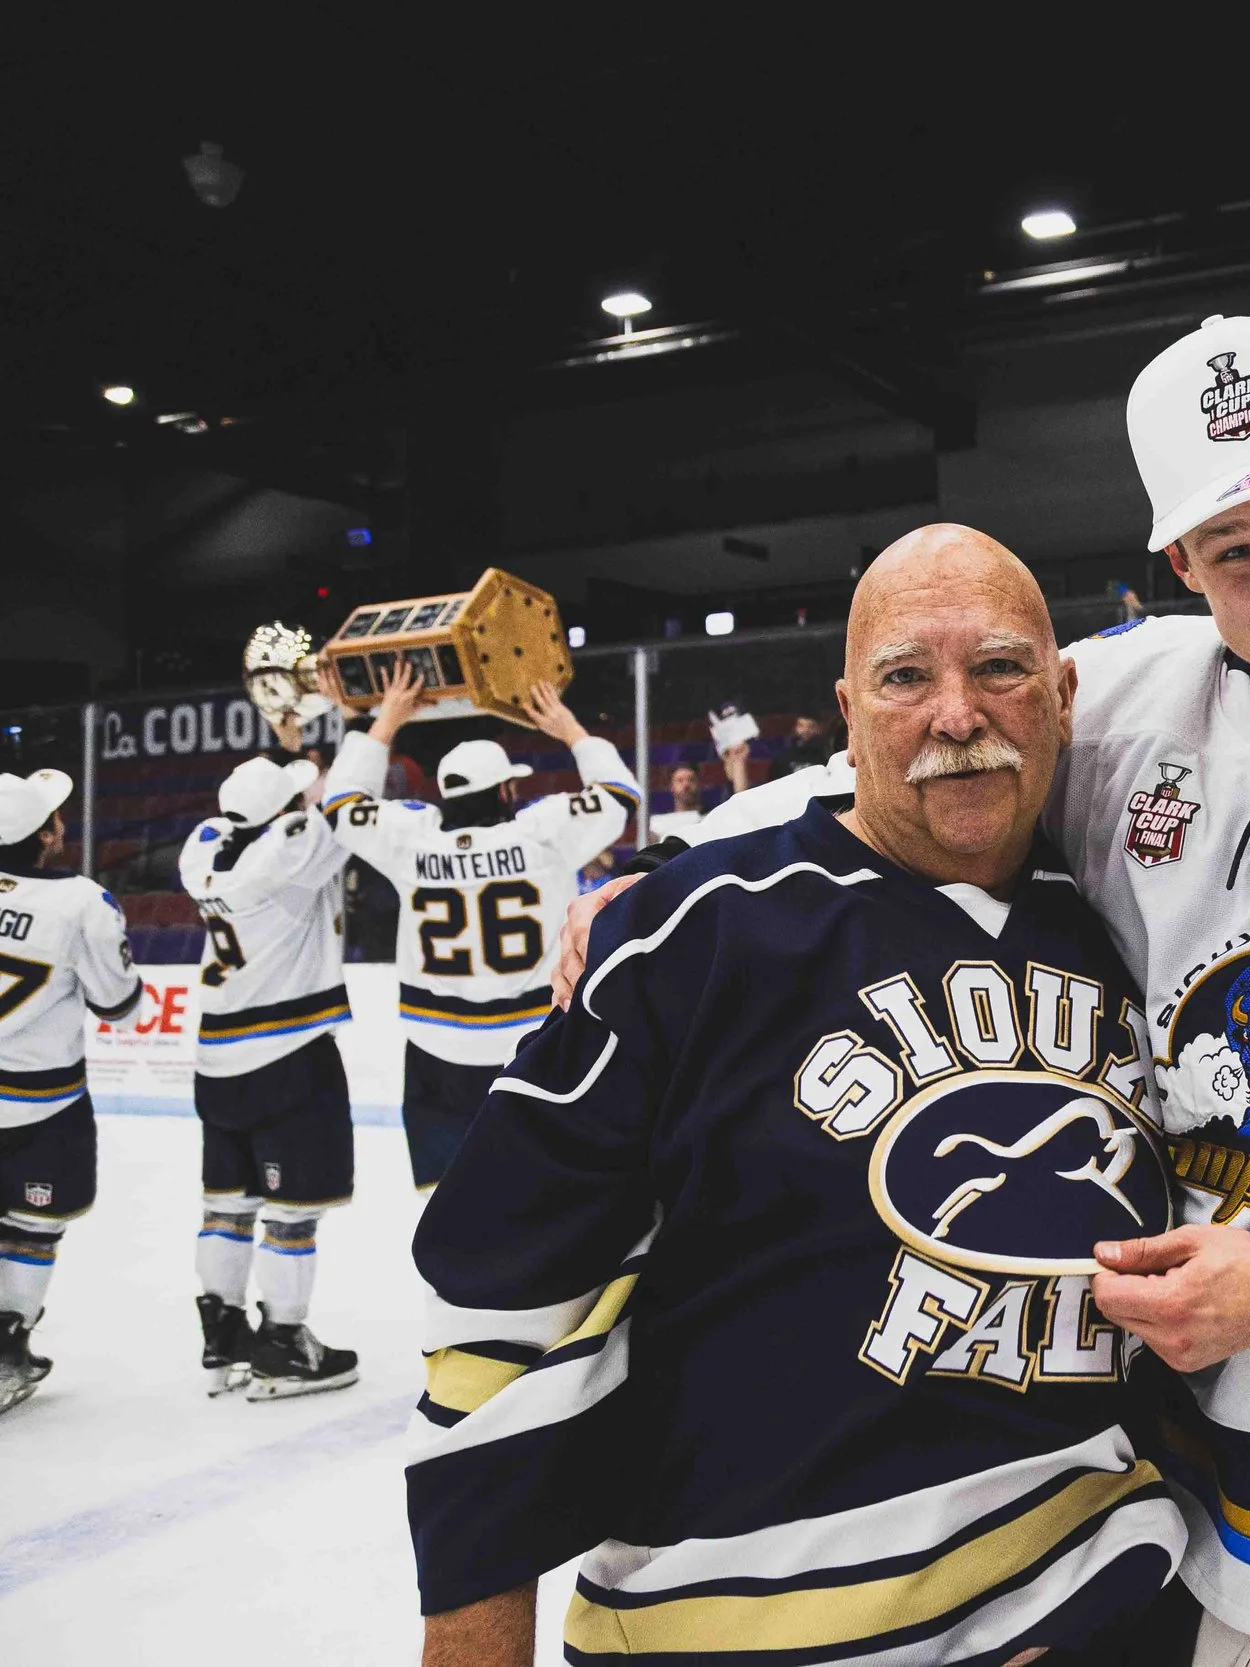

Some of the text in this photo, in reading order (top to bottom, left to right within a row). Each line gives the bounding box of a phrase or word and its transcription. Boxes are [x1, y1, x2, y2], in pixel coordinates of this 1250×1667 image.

[1129, 792, 1197, 819] CLARK
[1135, 812, 1179, 832] CUP
[1139, 830, 1168, 848] FINAL
[415, 846, 526, 881] MONTEIRO
[411, 879, 544, 977] 26
[97, 983, 189, 1034] CE
